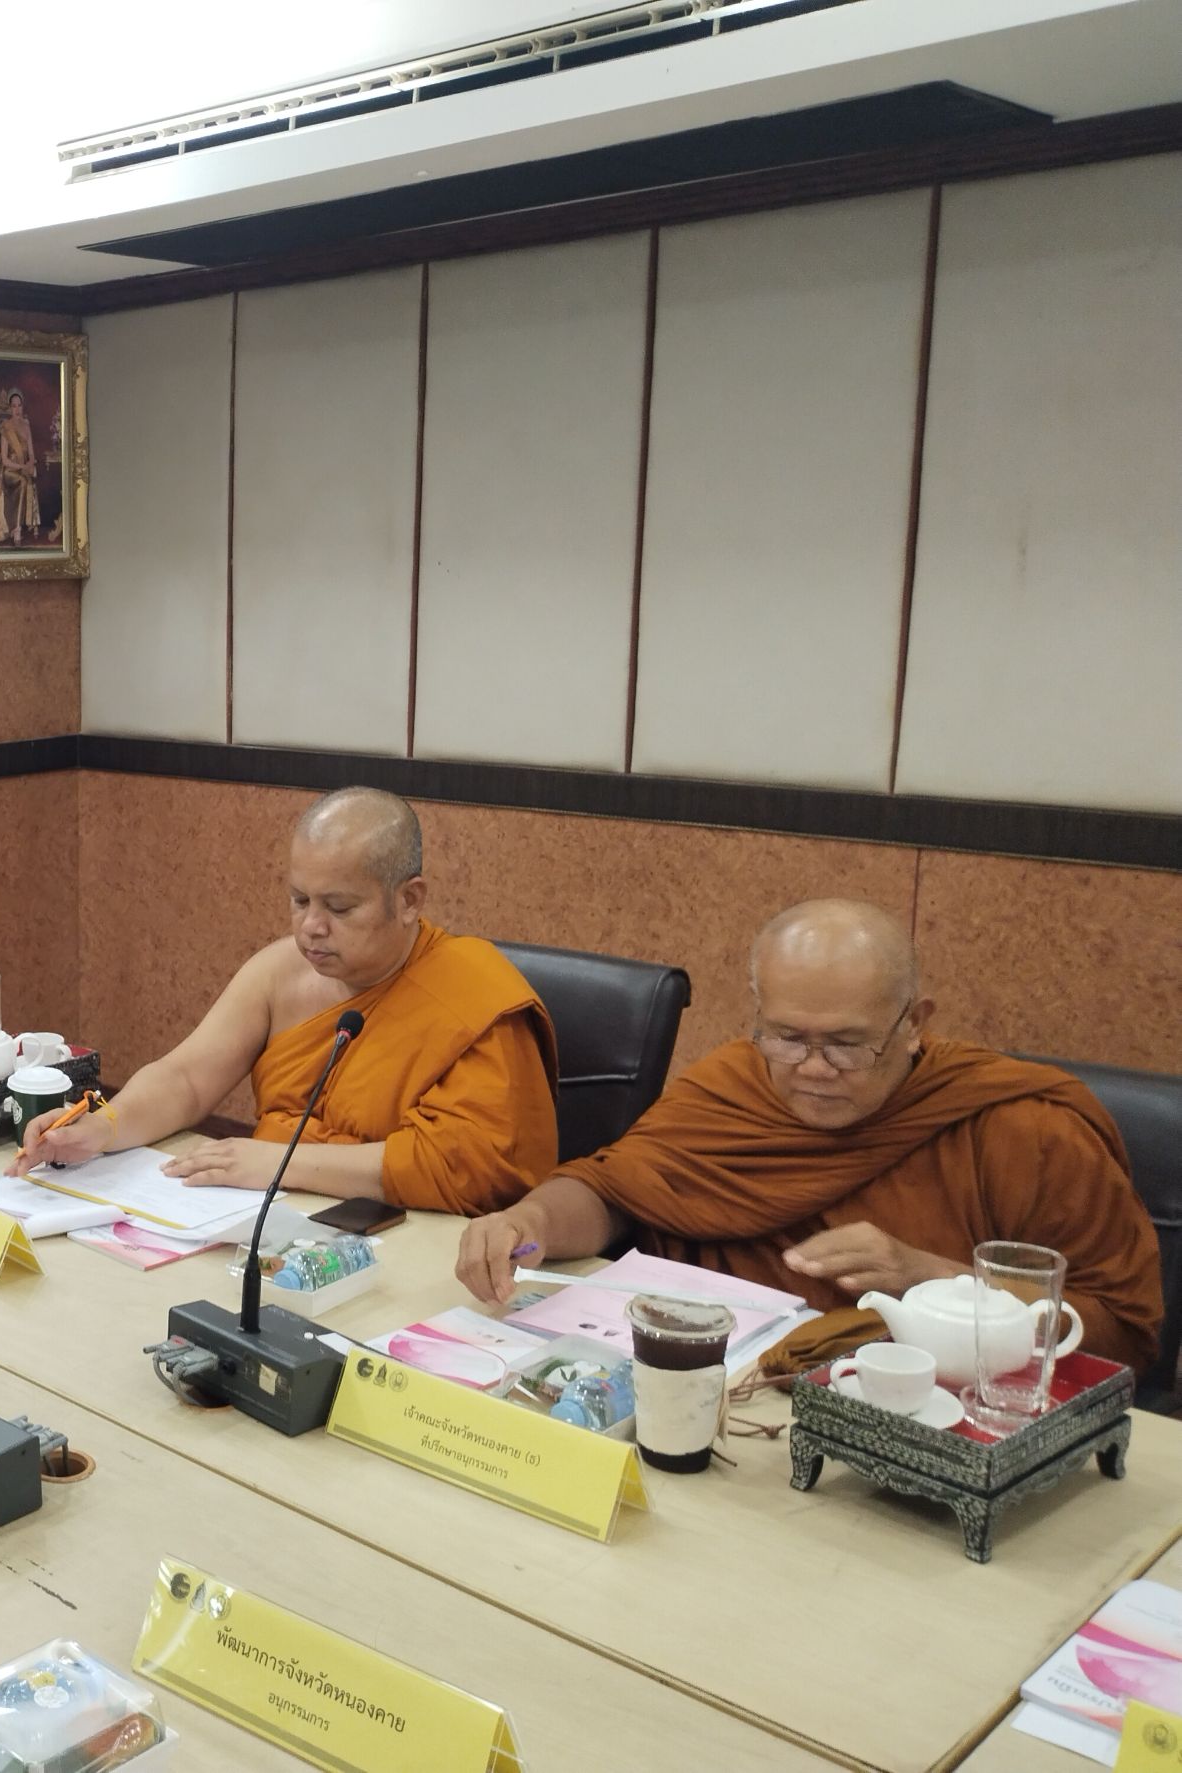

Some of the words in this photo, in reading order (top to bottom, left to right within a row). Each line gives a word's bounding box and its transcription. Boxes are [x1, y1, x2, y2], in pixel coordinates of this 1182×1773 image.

[403, 1404, 522, 1461] เจ้าคณะจังหวัดหนองคาย
[524, 1450, 542, 1468] (ธ)
[419, 1434, 509, 1480] ที่ปรึกษาอนุกรรมการ
[215, 1626, 407, 1734] พัฒนาการจังหวัดหนองคาย
[267, 1691, 331, 1732] อนุกรรมการ
